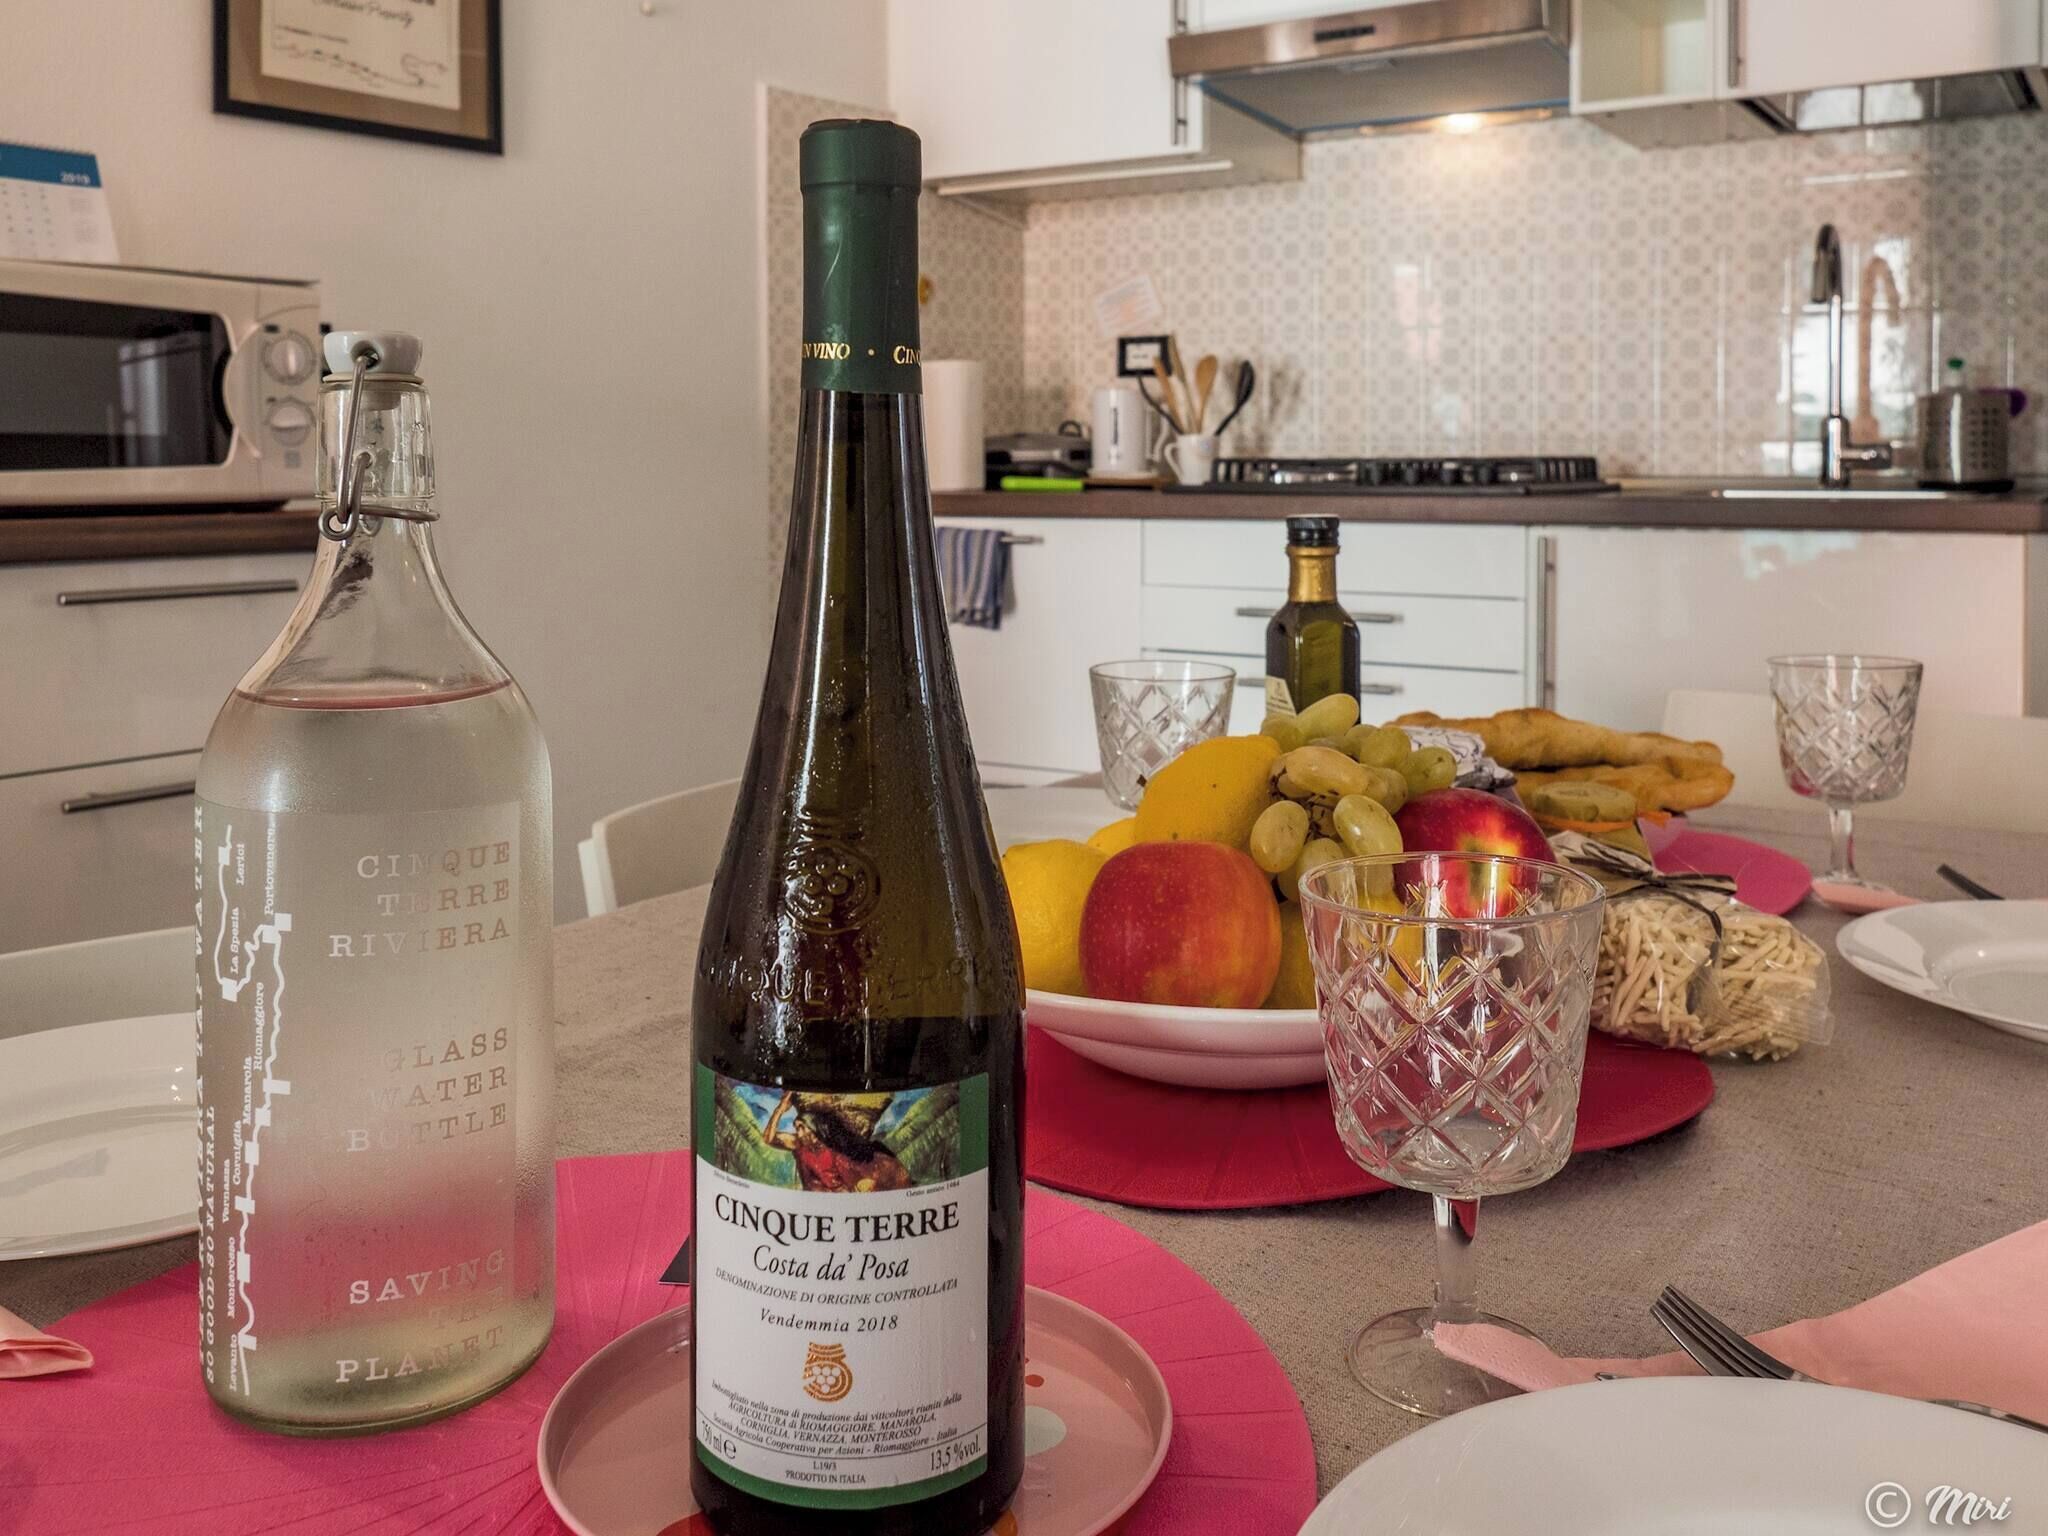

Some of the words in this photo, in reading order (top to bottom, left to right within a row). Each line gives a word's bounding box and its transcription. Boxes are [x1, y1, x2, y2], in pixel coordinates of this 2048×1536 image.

[813, 342, 851, 360] VINO
[236, 843, 245, 886] Lerici
[356, 841, 511, 878] CINQUE
[376, 879, 510, 916] TERRE
[327, 917, 511, 958] RIVIERA
[230, 955, 239, 974] La
[253, 981, 265, 1071] Riomaggiore
[383, 1027, 508, 1072] GLASS
[242, 1055, 252, 1125] Manarola
[368, 1066, 508, 1108] WATER
[346, 1103, 507, 1152] BOTTLE
[206, 1105, 215, 1232] NATURAL
[232, 1119, 243, 1185] Corniglia
[714, 1193, 836, 1247] CINQUE
[845, 1201, 960, 1243] TERRE
[227, 1236, 236, 1319] Monterosso
[349, 1249, 506, 1305] SAVING
[753, 1244, 809, 1279] Costa
[857, 1253, 910, 1282] Posa
[715, 1267, 798, 1302] DENOMINAZIONE
[800, 1292, 815, 1303] DI
[817, 1293, 871, 1305] ORIGINE
[875, 1278, 959, 1304] CONTROLLATA
[760, 1307, 850, 1333] Vendemmia
[857, 1315, 899, 1333] 2018
[206, 1350, 215, 1384] SO
[335, 1325, 504, 1384] PLANET
[728, 1401, 787, 1427] AGRICOLTURA
[787, 1420, 798, 1428] di
[769, 1408, 790, 1417] zona
[790, 1409, 801, 1418] di
[800, 1412, 851, 1423] produzione
[853, 1411, 868, 1422] dai
[765, 1437, 816, 1454] Cooperativa
[817, 1446, 834, 1456] per
[835, 1446, 865, 1455] Azioni
[873, 1437, 930, 1454] Riomaggiore
[850, 1425, 922, 1444] MONTEROSSO
[785, 1470, 829, 1483] PRODOTTO
[829, 1474, 839, 1483] IN
[840, 1474, 867, 1484] ITALIA
